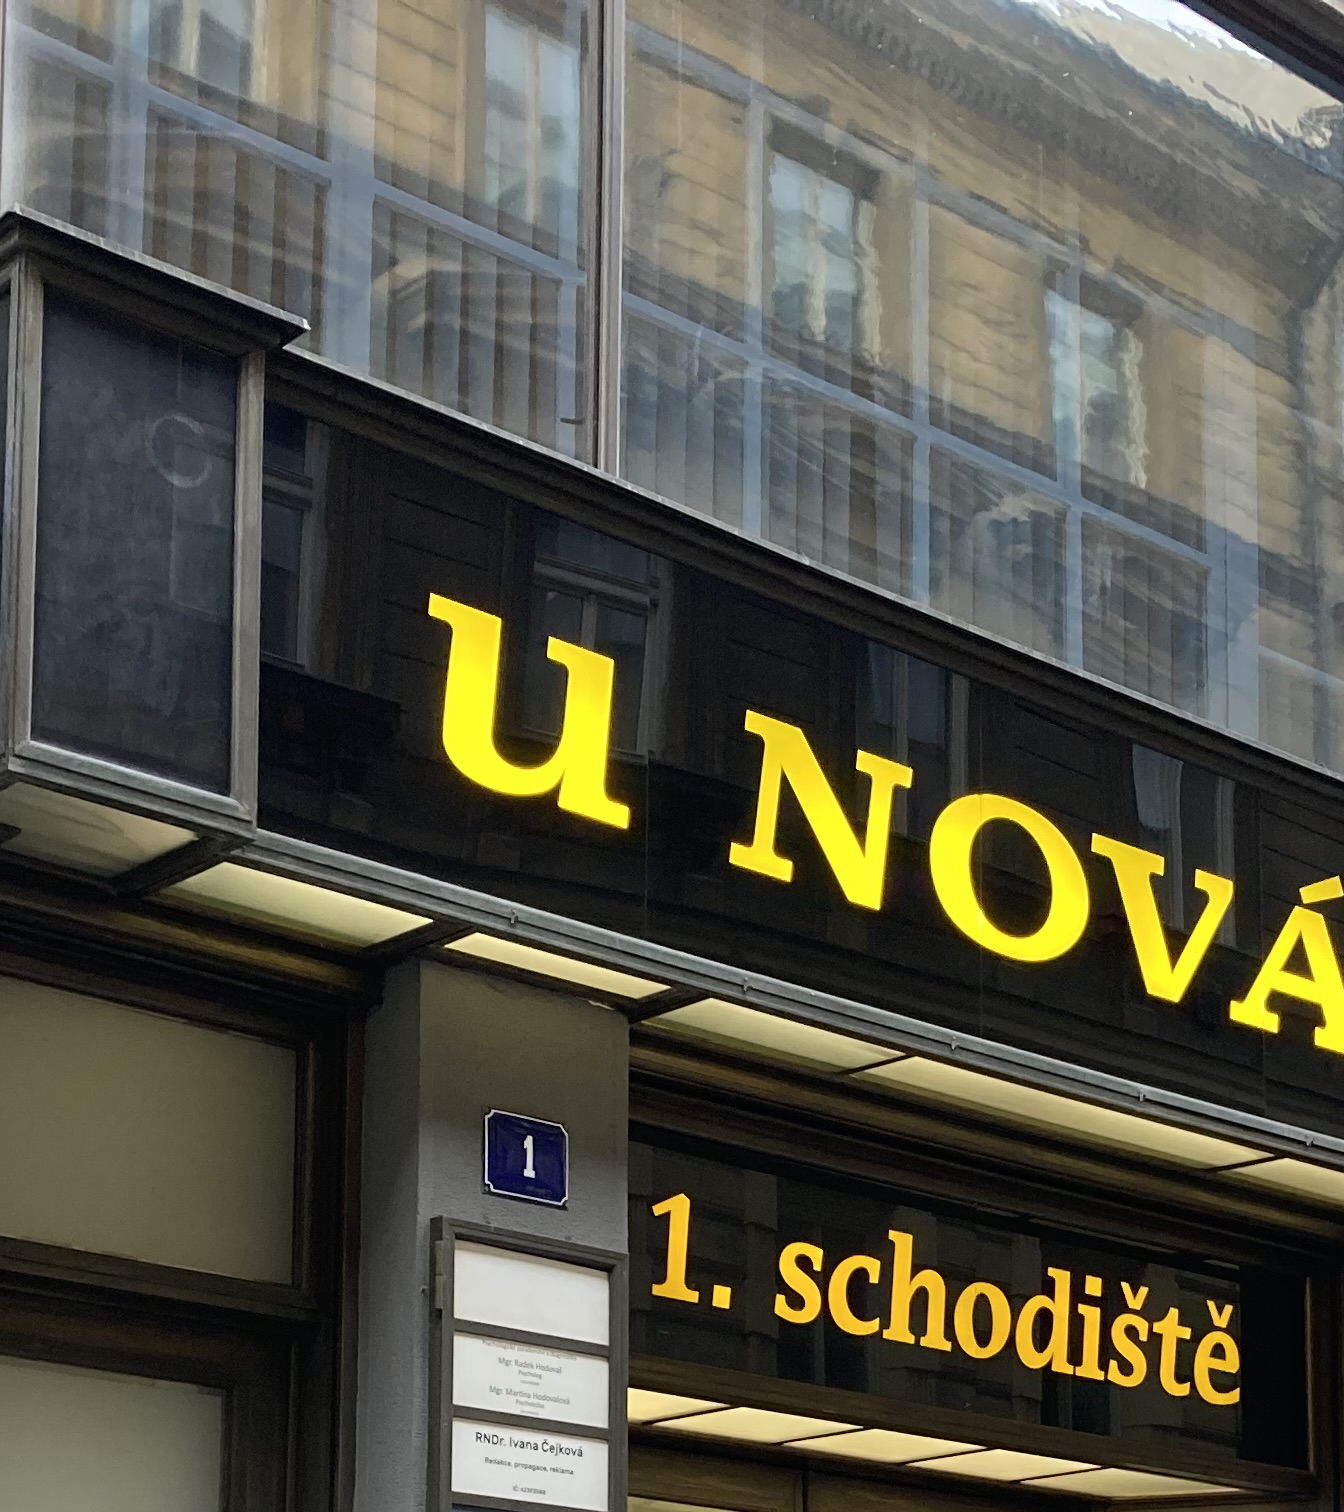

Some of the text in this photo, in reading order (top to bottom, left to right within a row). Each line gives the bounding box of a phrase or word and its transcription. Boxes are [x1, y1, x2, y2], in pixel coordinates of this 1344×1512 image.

[523, 1135, 536, 1179] 1
[651, 1193, 1242, 1407] 1. schodiště
[476, 1432, 583, 1457] RNDr. Ivana Čejková
